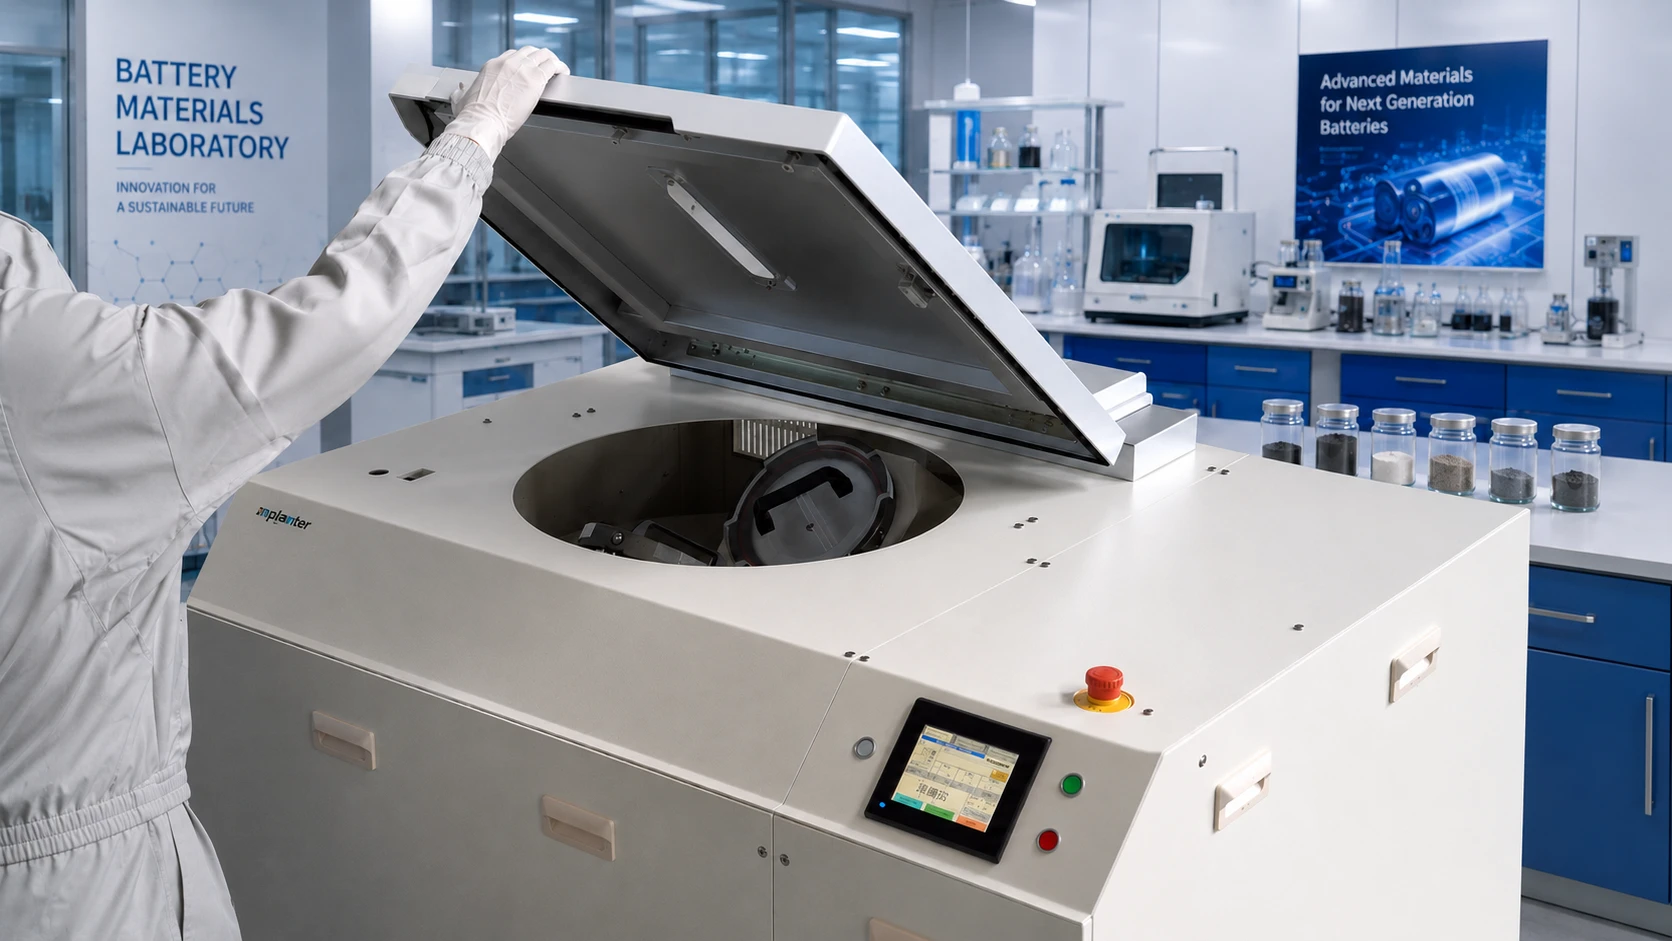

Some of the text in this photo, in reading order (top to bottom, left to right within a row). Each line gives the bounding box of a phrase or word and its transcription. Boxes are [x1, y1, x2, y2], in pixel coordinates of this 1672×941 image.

[116, 57, 237, 89] BATTERY
[1320, 66, 1474, 90] Advanced Materials
[116, 94, 264, 125] MATERIALS
[1320, 90, 1474, 113] for Next Generation
[1320, 117, 1389, 136] Batteries
[116, 130, 289, 160] LABORATORY
[116, 182, 216, 194] INNOVATION FOR
[116, 201, 254, 213] A SUSTAINABLE FUTURE
